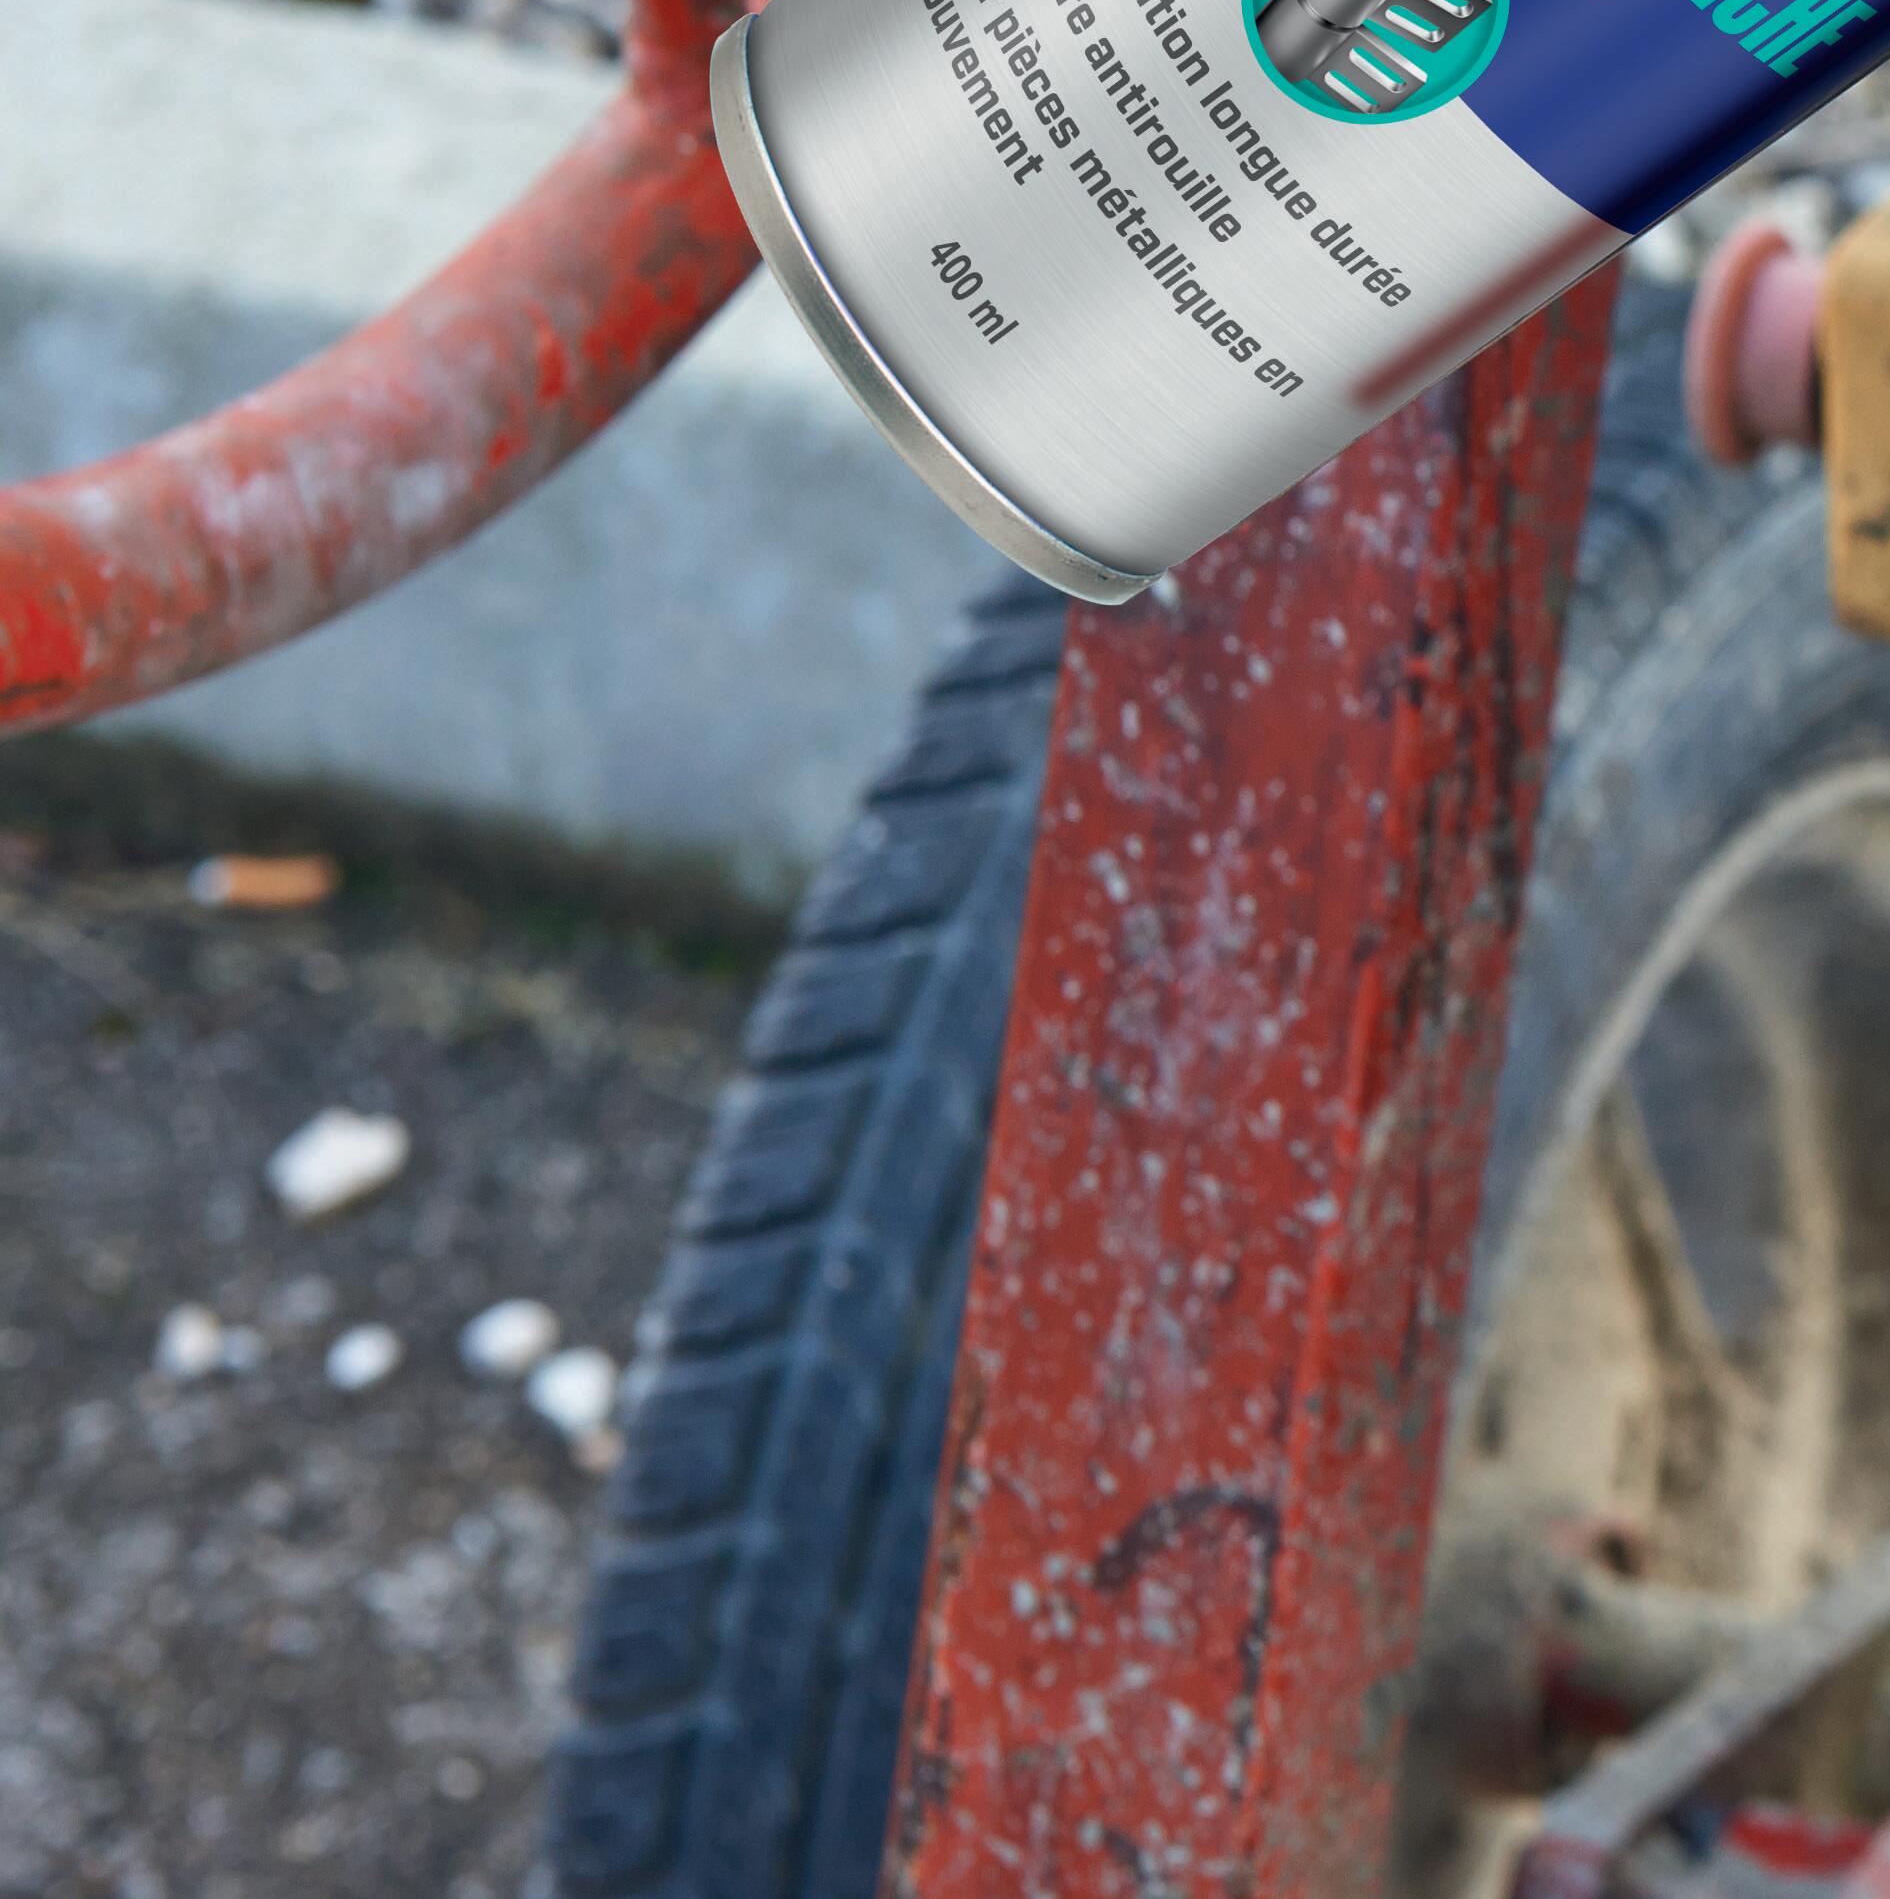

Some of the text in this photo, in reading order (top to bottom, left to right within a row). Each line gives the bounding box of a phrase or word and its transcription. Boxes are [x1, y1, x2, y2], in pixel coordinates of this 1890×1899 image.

[984, 12, 1079, 148] pièces
[1070, 149, 1261, 362] métalliques
[1255, 359, 1303, 397] en
[1085, 38, 1241, 242] antirouille
[1200, 81, 1316, 219] longue
[1311, 220, 1410, 306] durée
[932, 242, 1019, 344] 400 ml
